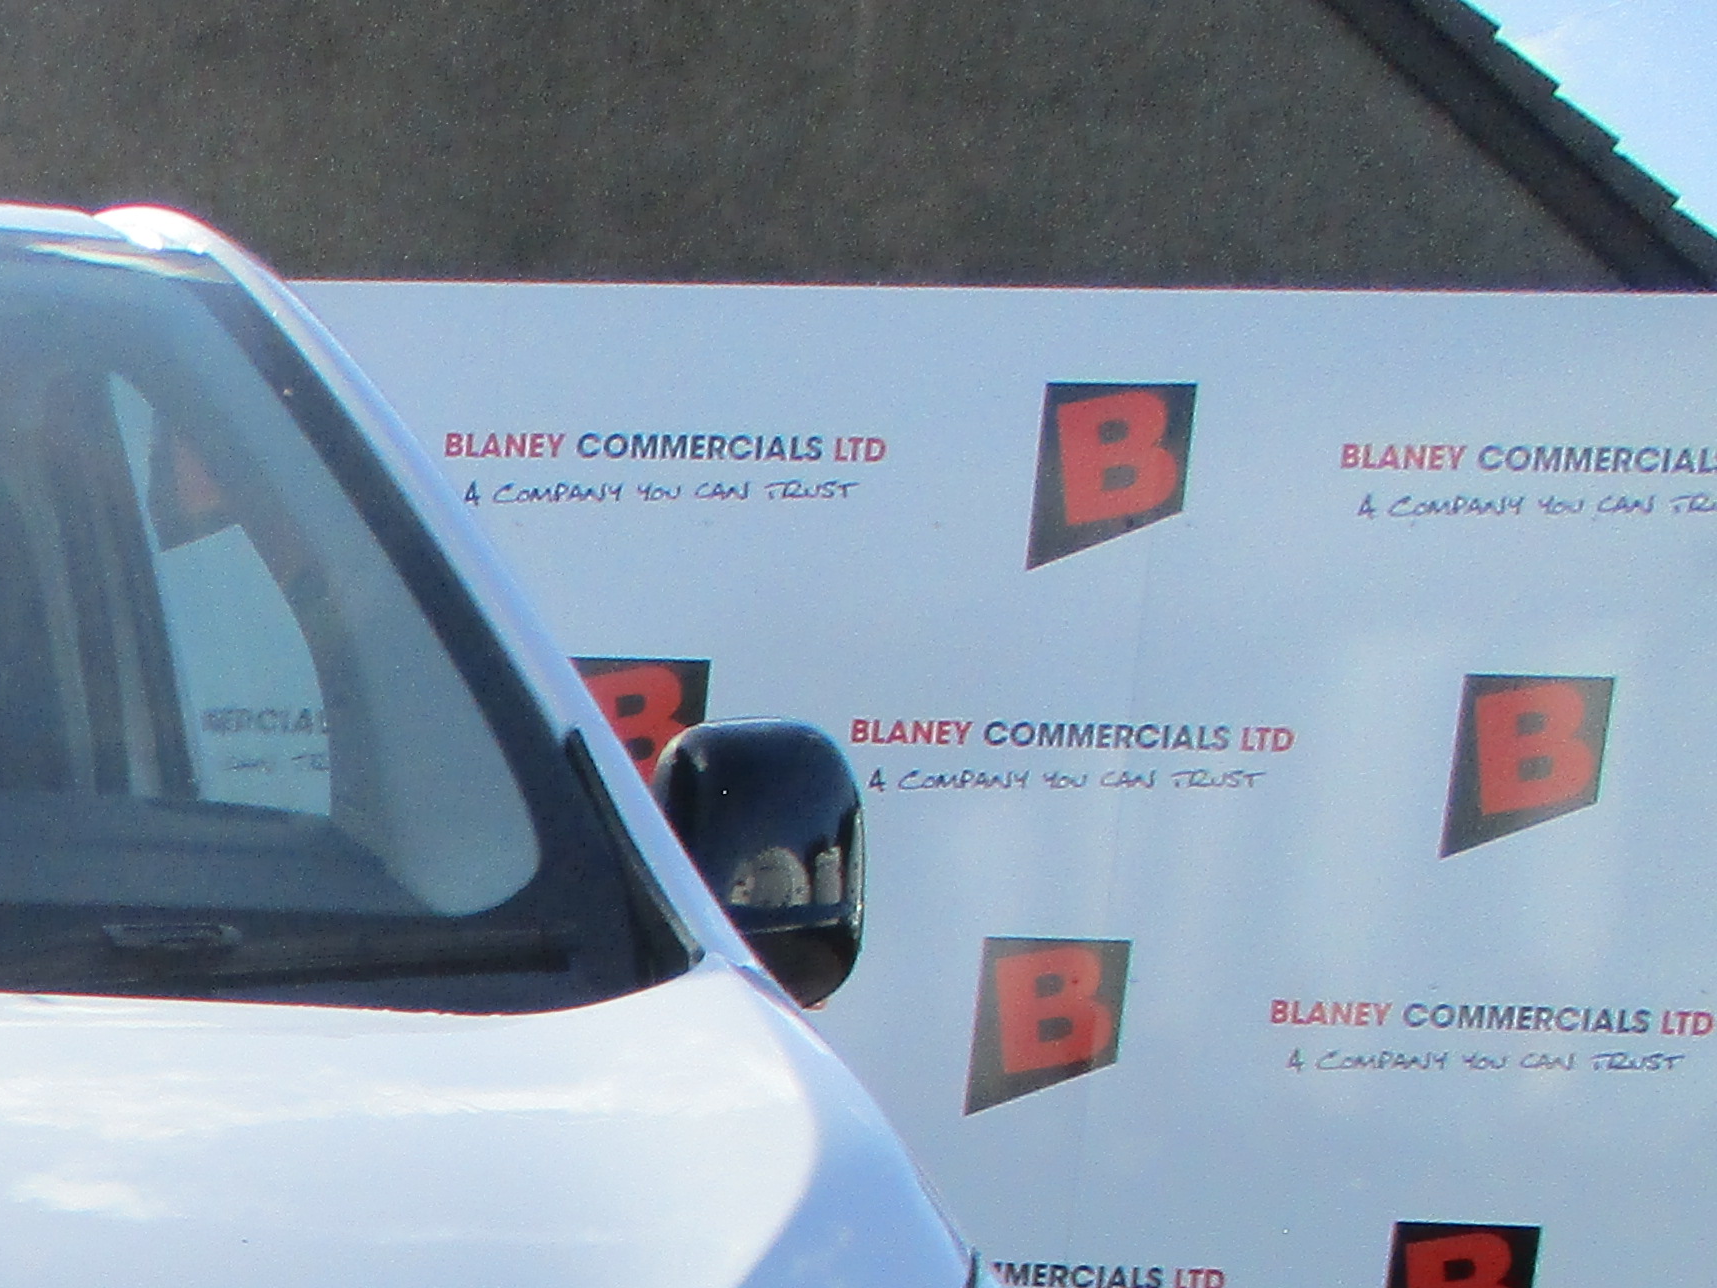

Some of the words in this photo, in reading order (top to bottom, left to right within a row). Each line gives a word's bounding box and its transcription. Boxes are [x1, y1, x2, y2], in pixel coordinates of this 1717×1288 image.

[444, 432, 566, 458] BLANEY
[576, 432, 823, 461] COMMERCIALS
[834, 436, 886, 462] LTD
[1057, 390, 1178, 526] B
[1340, 443, 1467, 470] BLANEY
[1478, 445, 1717, 473] COMMERCIAL
[464, 480, 479, 506] A
[492, 481, 623, 504] COMPANY
[637, 482, 682, 501] YOU
[694, 481, 749, 500] CAN
[764, 478, 860, 500] TRUST
[1358, 494, 1375, 519] A
[1387, 495, 1524, 517] COMPANY
[1538, 497, 1584, 515] YOU
[1597, 495, 1656, 515] CAN
[1670, 492, 1717, 514] TR
[849, 719, 973, 745] BLANEY
[983, 721, 1231, 751] COMMERCIALS
[1239, 726, 1295, 752] LTD
[1475, 680, 1595, 815] B
[867, 767, 885, 791] A
[898, 768, 1031, 790] COMPANY
[1043, 771, 1087, 788] YOU
[1100, 768, 1157, 789] CAN
[1171, 768, 1267, 788] TRUST
[995, 946, 1111, 1075] B
[1270, 1000, 1393, 1026] BLANEY
[1402, 1002, 1651, 1034] COMMERCIALS
[1659, 1009, 1715, 1036] LTD
[1285, 1047, 1303, 1071] A
[1315, 1049, 1446, 1071] COMPANY
[1463, 1052, 1507, 1070] YOU
[1519, 1050, 1575, 1071] CAN
[1590, 1051, 1685, 1071] TRUST
